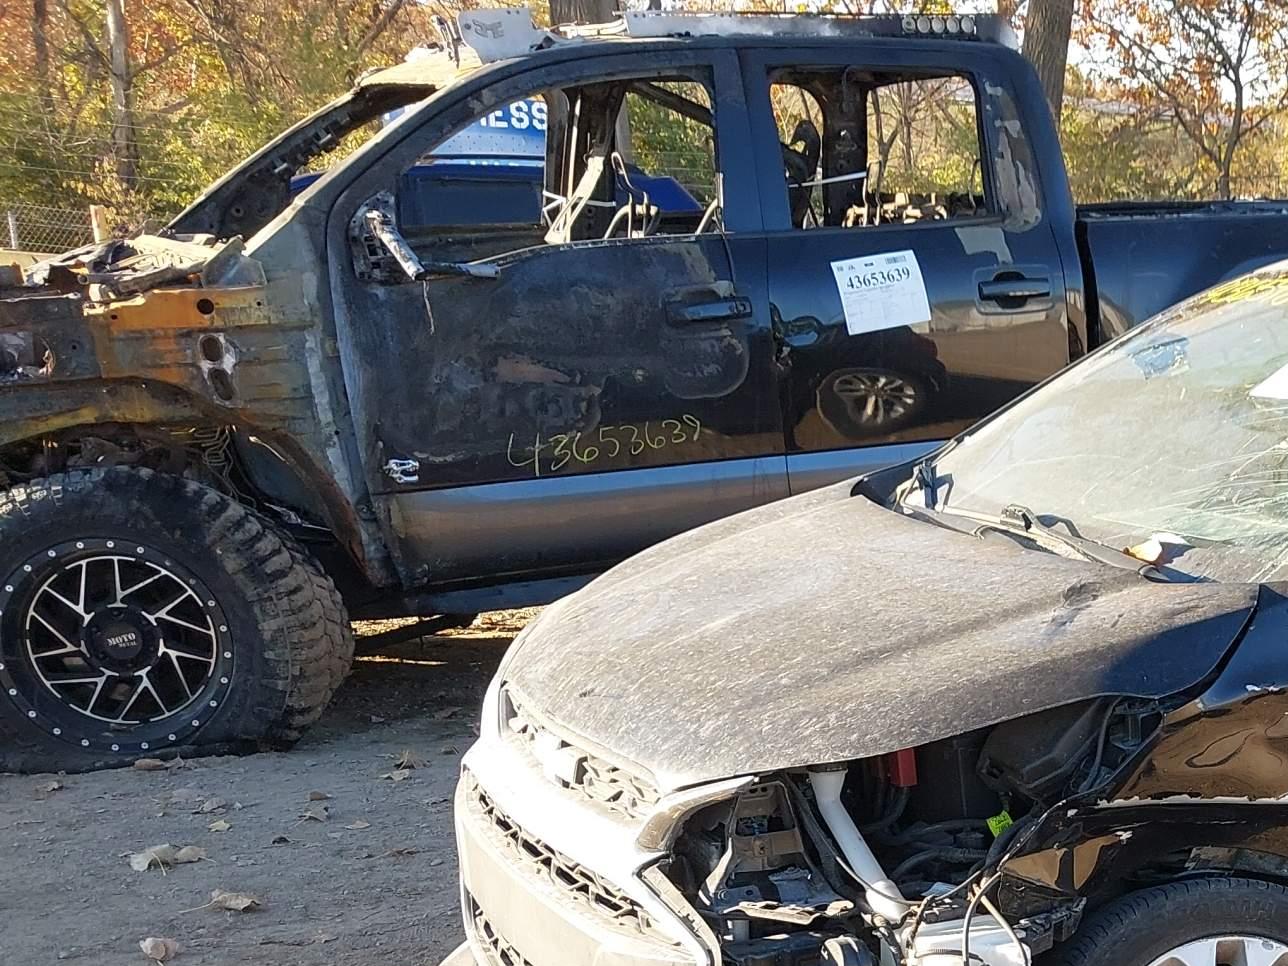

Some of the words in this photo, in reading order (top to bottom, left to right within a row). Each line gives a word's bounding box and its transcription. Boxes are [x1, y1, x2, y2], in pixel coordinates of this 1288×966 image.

[846, 266, 911, 290] 43653639
[506, 414, 701, 477] 43653639
[106, 632, 136, 646] MOTO
